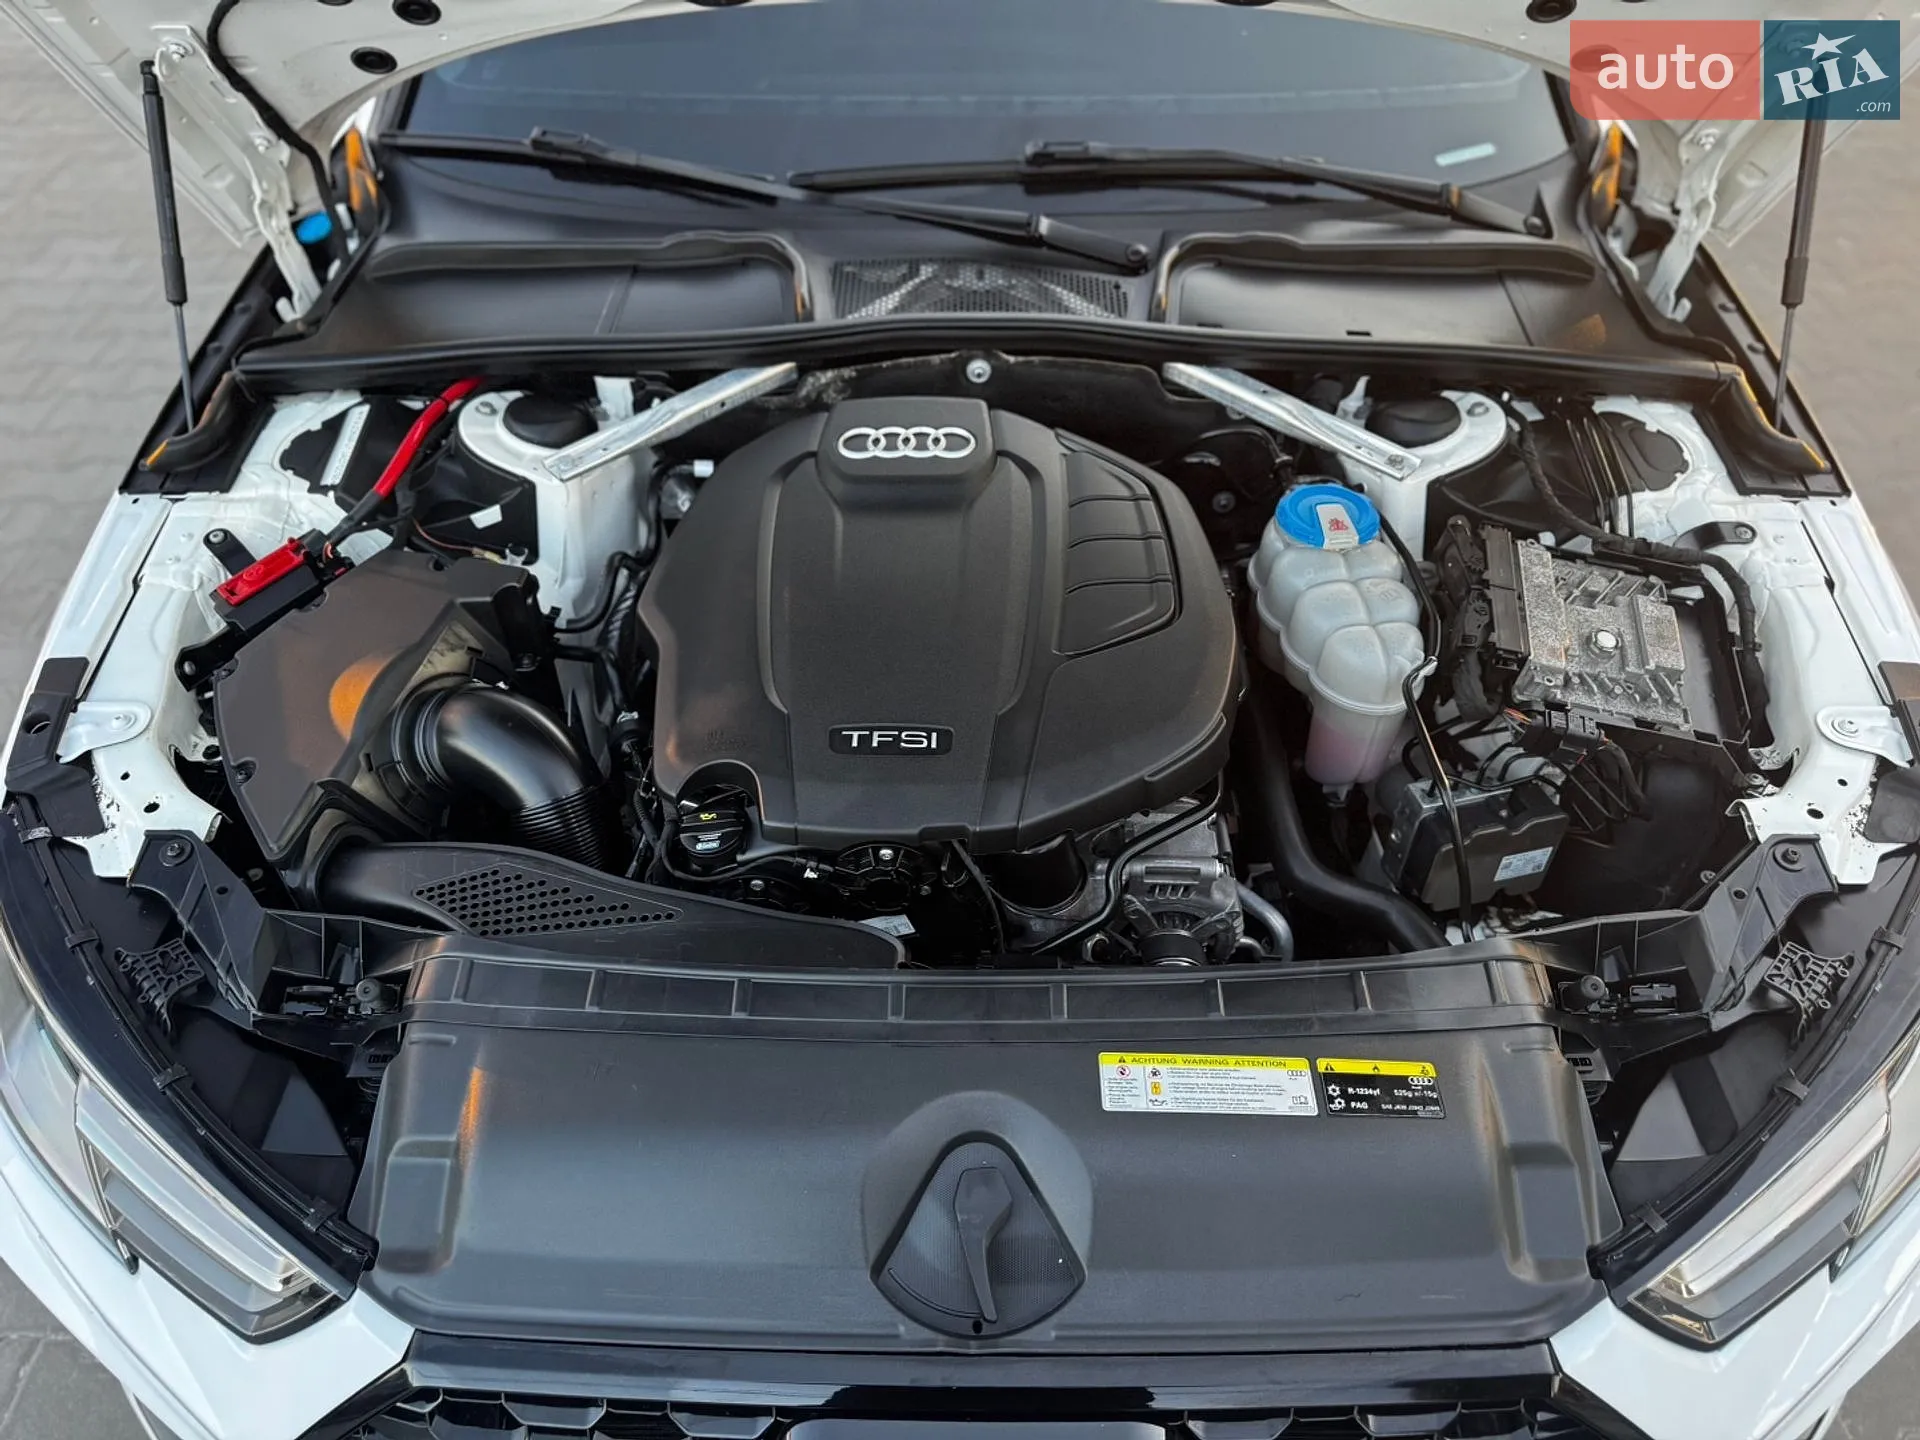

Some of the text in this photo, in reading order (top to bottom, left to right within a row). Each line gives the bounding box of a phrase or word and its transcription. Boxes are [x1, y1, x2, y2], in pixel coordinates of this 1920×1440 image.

[841, 731, 937, 749] TFSI
[1181, 1058, 1229, 1066] WARNING
[1234, 1060, 1287, 1068] ATTENTION
